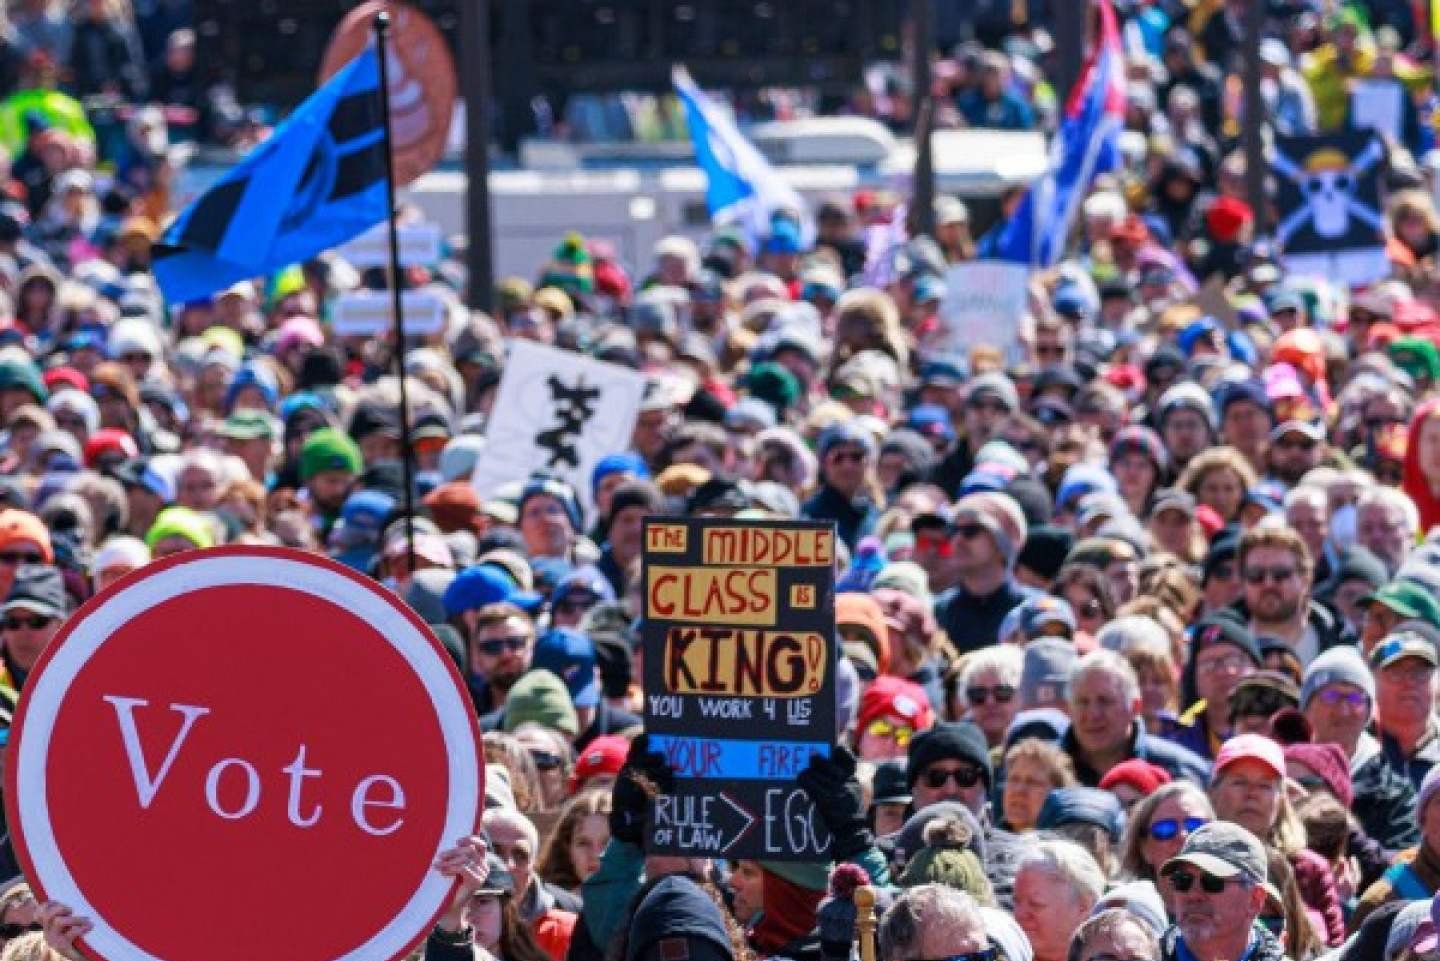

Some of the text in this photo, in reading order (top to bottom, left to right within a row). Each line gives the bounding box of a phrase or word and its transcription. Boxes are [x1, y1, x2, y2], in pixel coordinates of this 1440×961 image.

[708, 528, 829, 564] MIDDLE
[652, 570, 771, 617] CLASS
[669, 629, 822, 693] KING!
[649, 696, 812, 724] YOU WORK 4 US
[103, 695, 407, 836] Vote
[665, 740, 723, 779] YOUR
[654, 795, 717, 828] RULE
[678, 826, 724, 850] LAW
